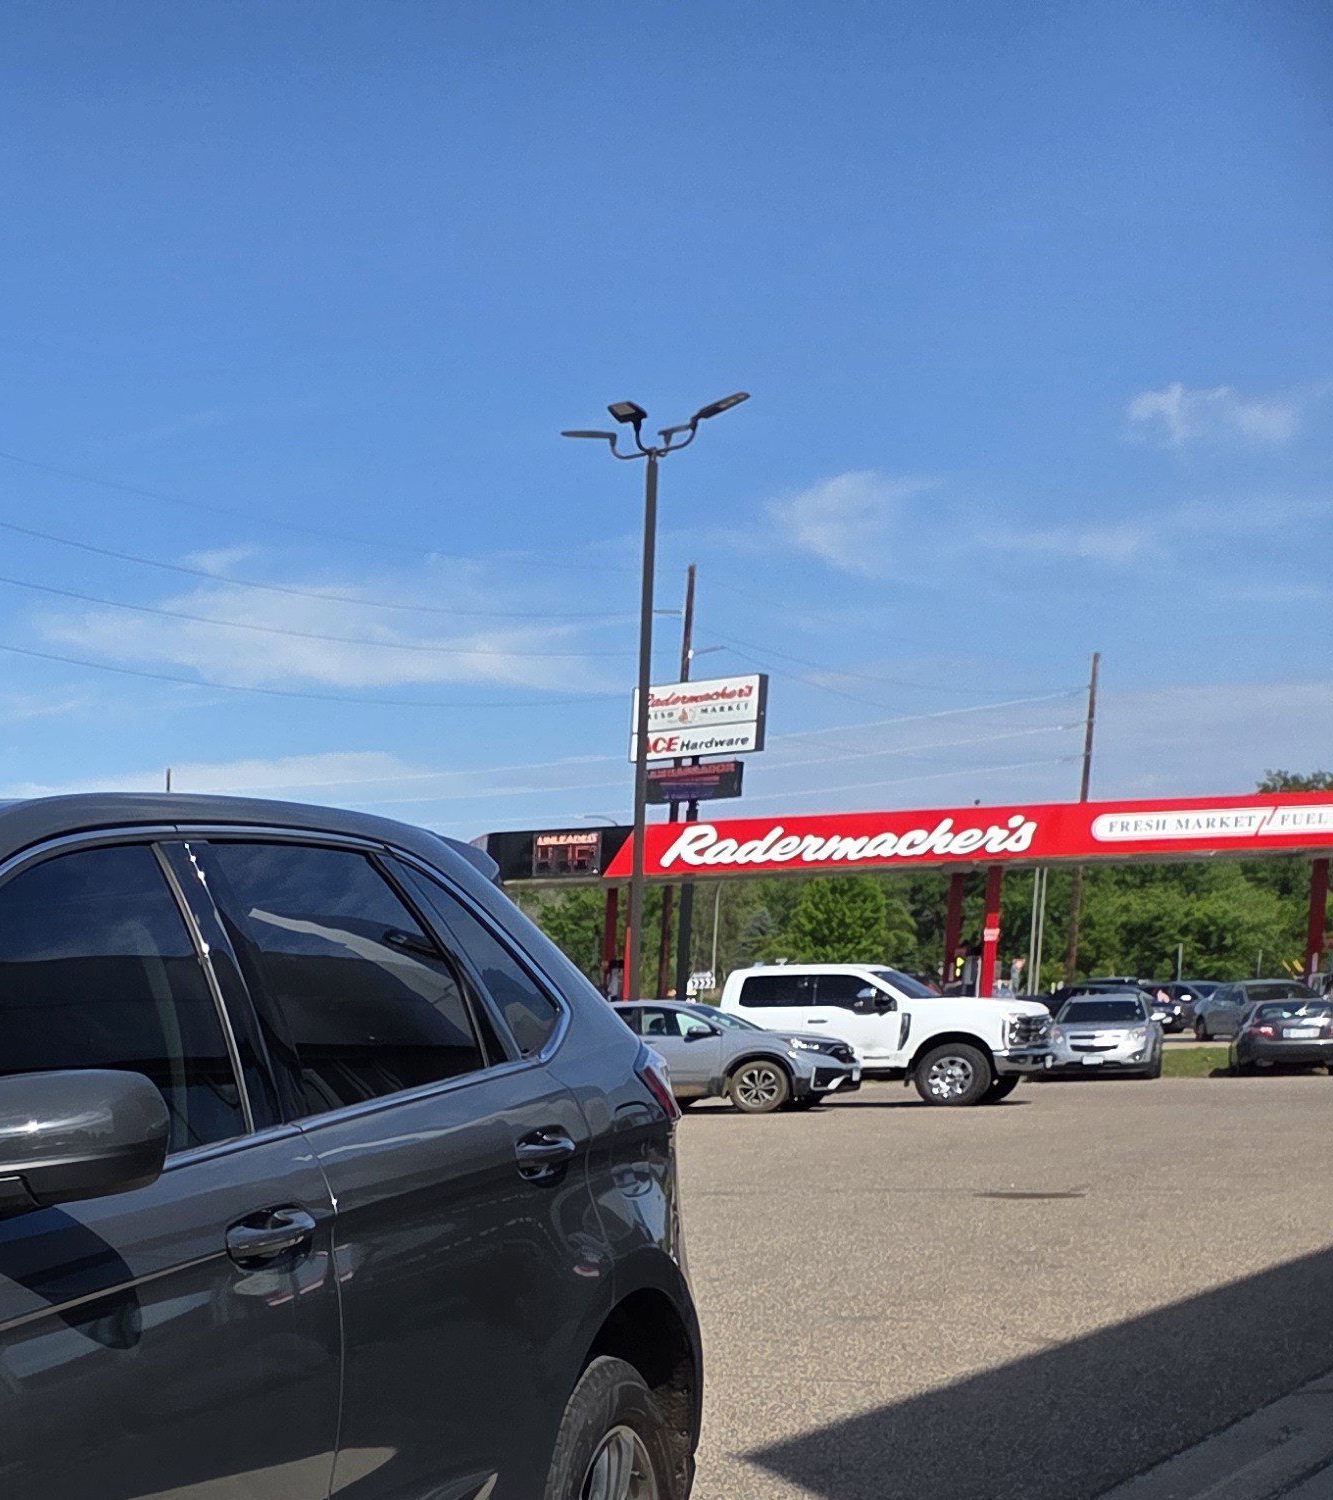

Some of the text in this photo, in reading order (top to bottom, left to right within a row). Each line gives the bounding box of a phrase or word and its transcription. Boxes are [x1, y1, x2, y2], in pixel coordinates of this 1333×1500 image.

[700, 703, 749, 714] MARKET
[680, 737, 749, 751] Hardware
[1108, 819, 1167, 833] FRESH
[1174, 814, 1258, 832] MARKET
[660, 815, 1038, 867] Radermacher's
